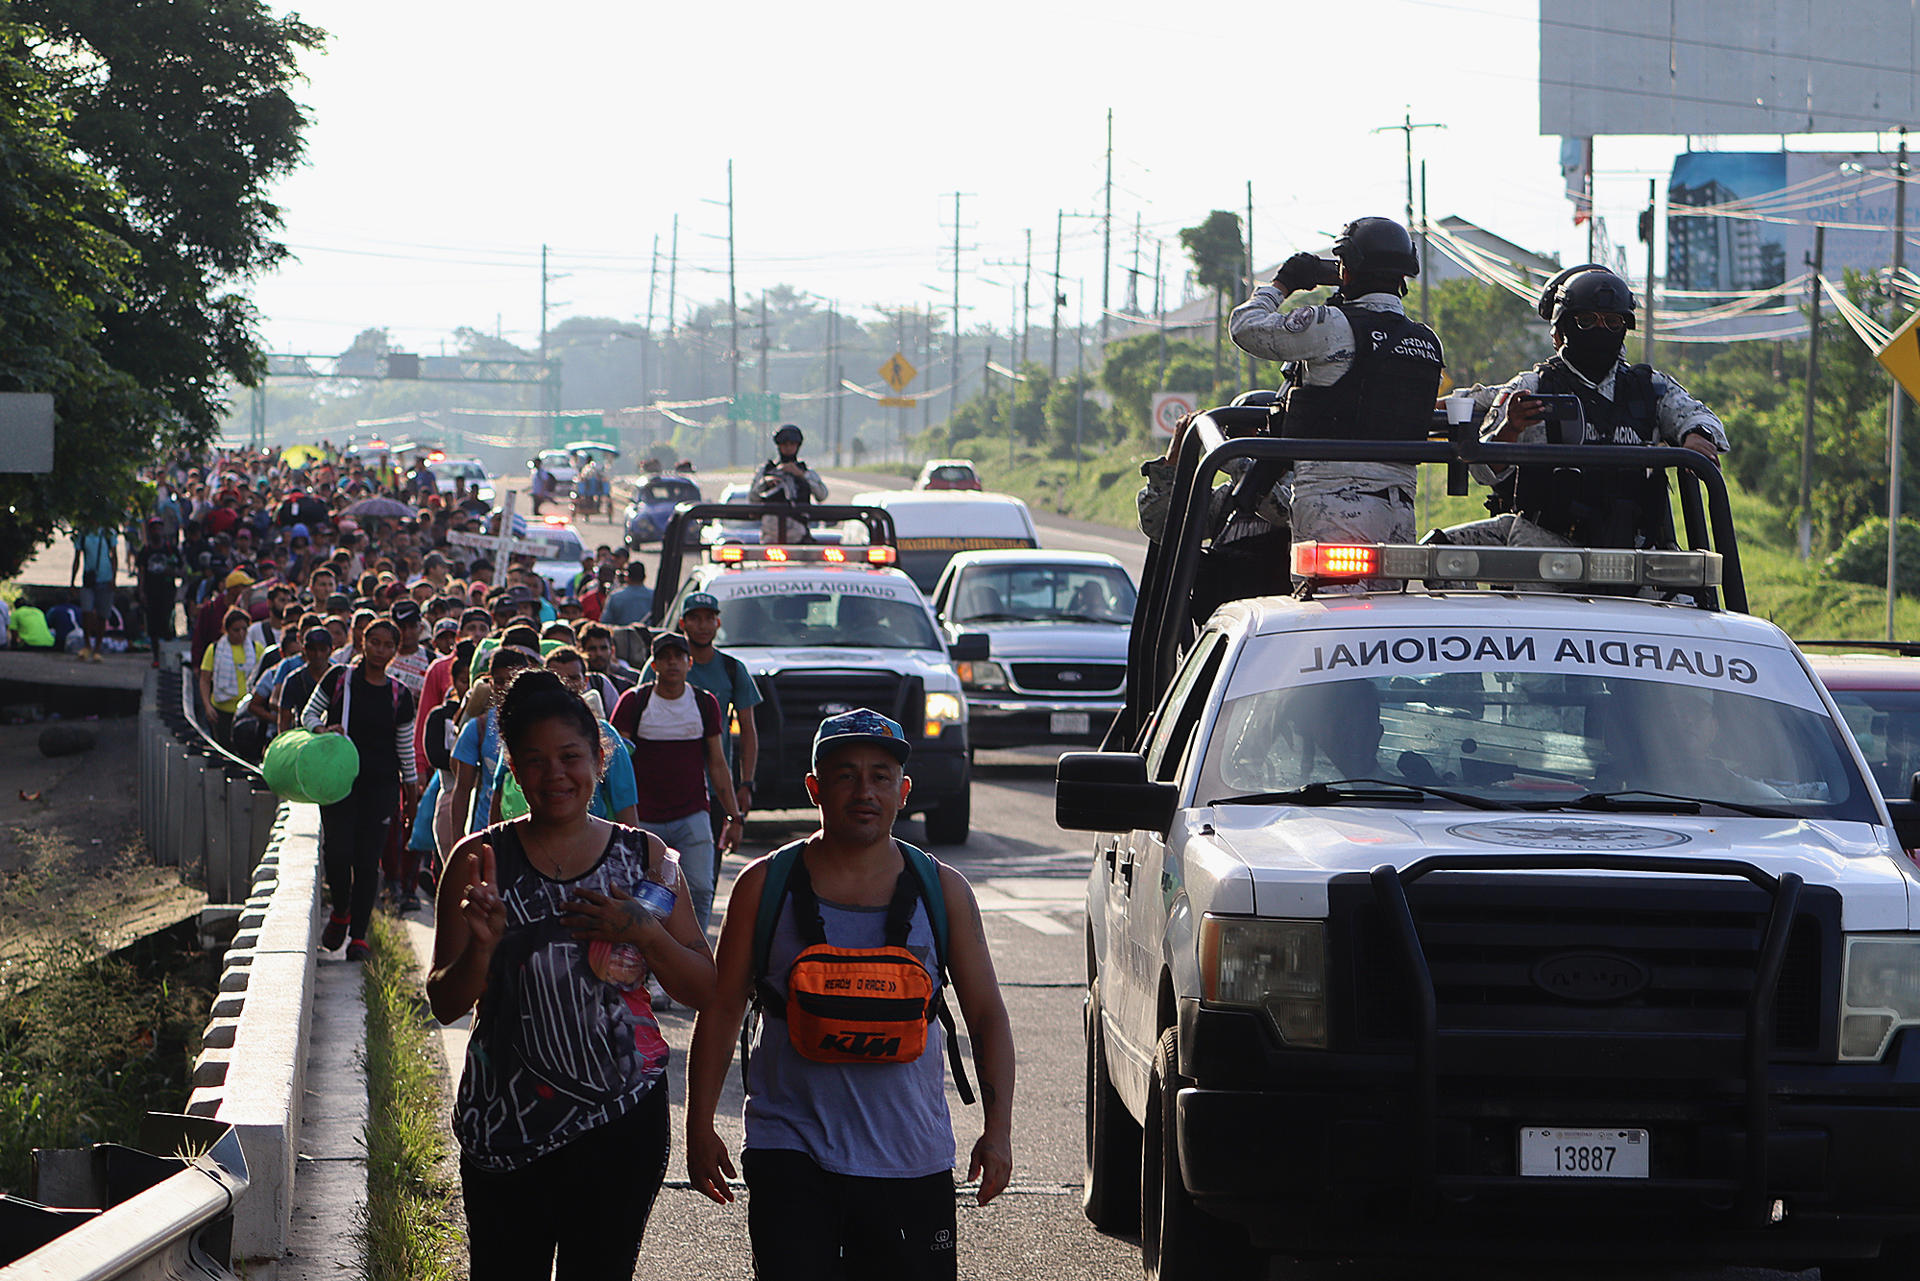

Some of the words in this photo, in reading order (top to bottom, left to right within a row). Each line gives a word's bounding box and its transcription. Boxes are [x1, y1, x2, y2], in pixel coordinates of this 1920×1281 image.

[864, 979, 885, 991] RACE
[818, 1031, 902, 1057] KTM
[1554, 1146, 1617, 1172] 13887
